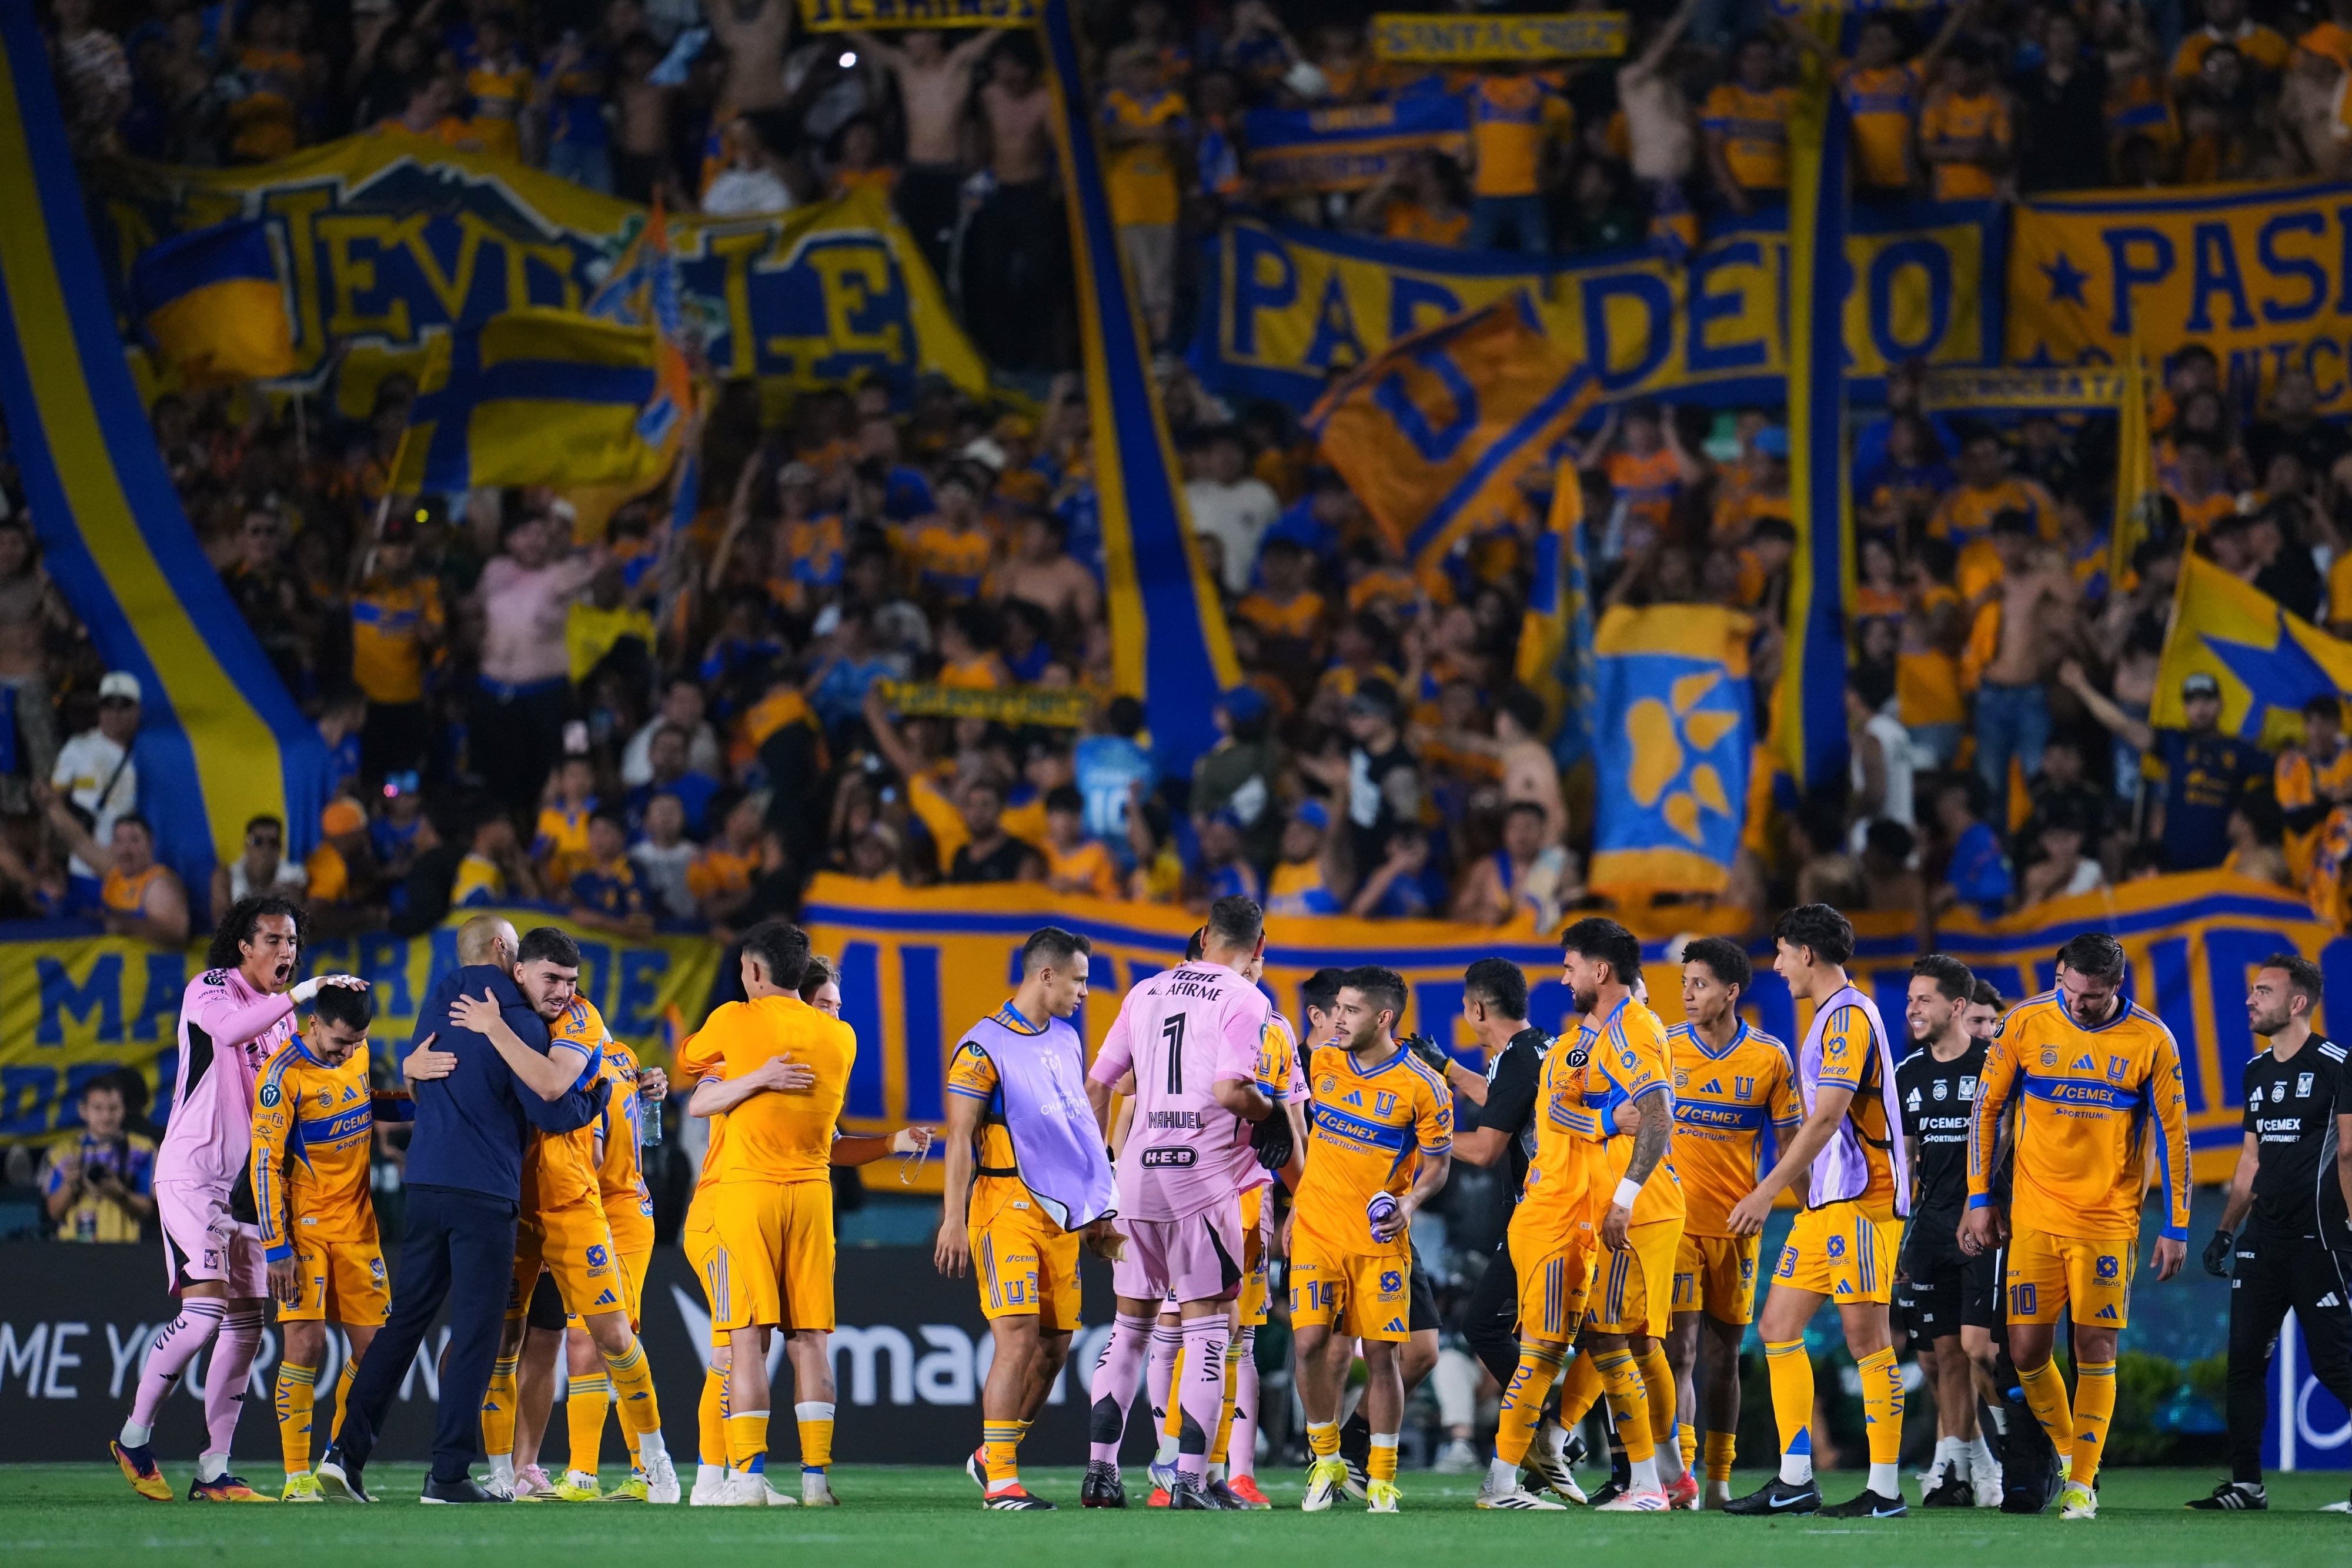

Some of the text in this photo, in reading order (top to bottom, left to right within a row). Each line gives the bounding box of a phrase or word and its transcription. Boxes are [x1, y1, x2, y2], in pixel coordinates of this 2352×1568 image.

[1174, 970, 1222, 982] TECATE
[1165, 982, 1224, 1001] AFIRME
[1163, 1012, 1186, 1094] 1
[956, 1057, 988, 1074] smart fit
[1630, 1058, 1643, 1075] Berel
[1821, 1064, 1850, 1075] telcel
[2107, 1055, 2130, 1081] U
[1629, 1069, 1651, 1092] telcel
[1735, 1076, 1754, 1098] U
[2066, 1087, 2115, 1104] CEMEX
[255, 1112, 284, 1128] smart fit
[1148, 1111, 1205, 1129] NAHUEL
[1690, 1109, 1743, 1125] CEMEX
[1929, 1117, 1970, 1129] CEMEX
[2052, 1107, 2113, 1122] SPORTIUMBET
[1327, 1116, 1379, 1141] CEMEX
[2264, 1119, 2301, 1131] CEMEX
[1674, 1126, 1737, 1143] SPORTIUMBET
[1921, 1133, 1969, 1145] SPORTIUMBE
[1316, 1132, 1374, 1156] SPORTIUMBET
[314, 1276, 325, 1309] 7
[1307, 1280, 1334, 1312] 14
[2010, 1283, 2037, 1316] 10
